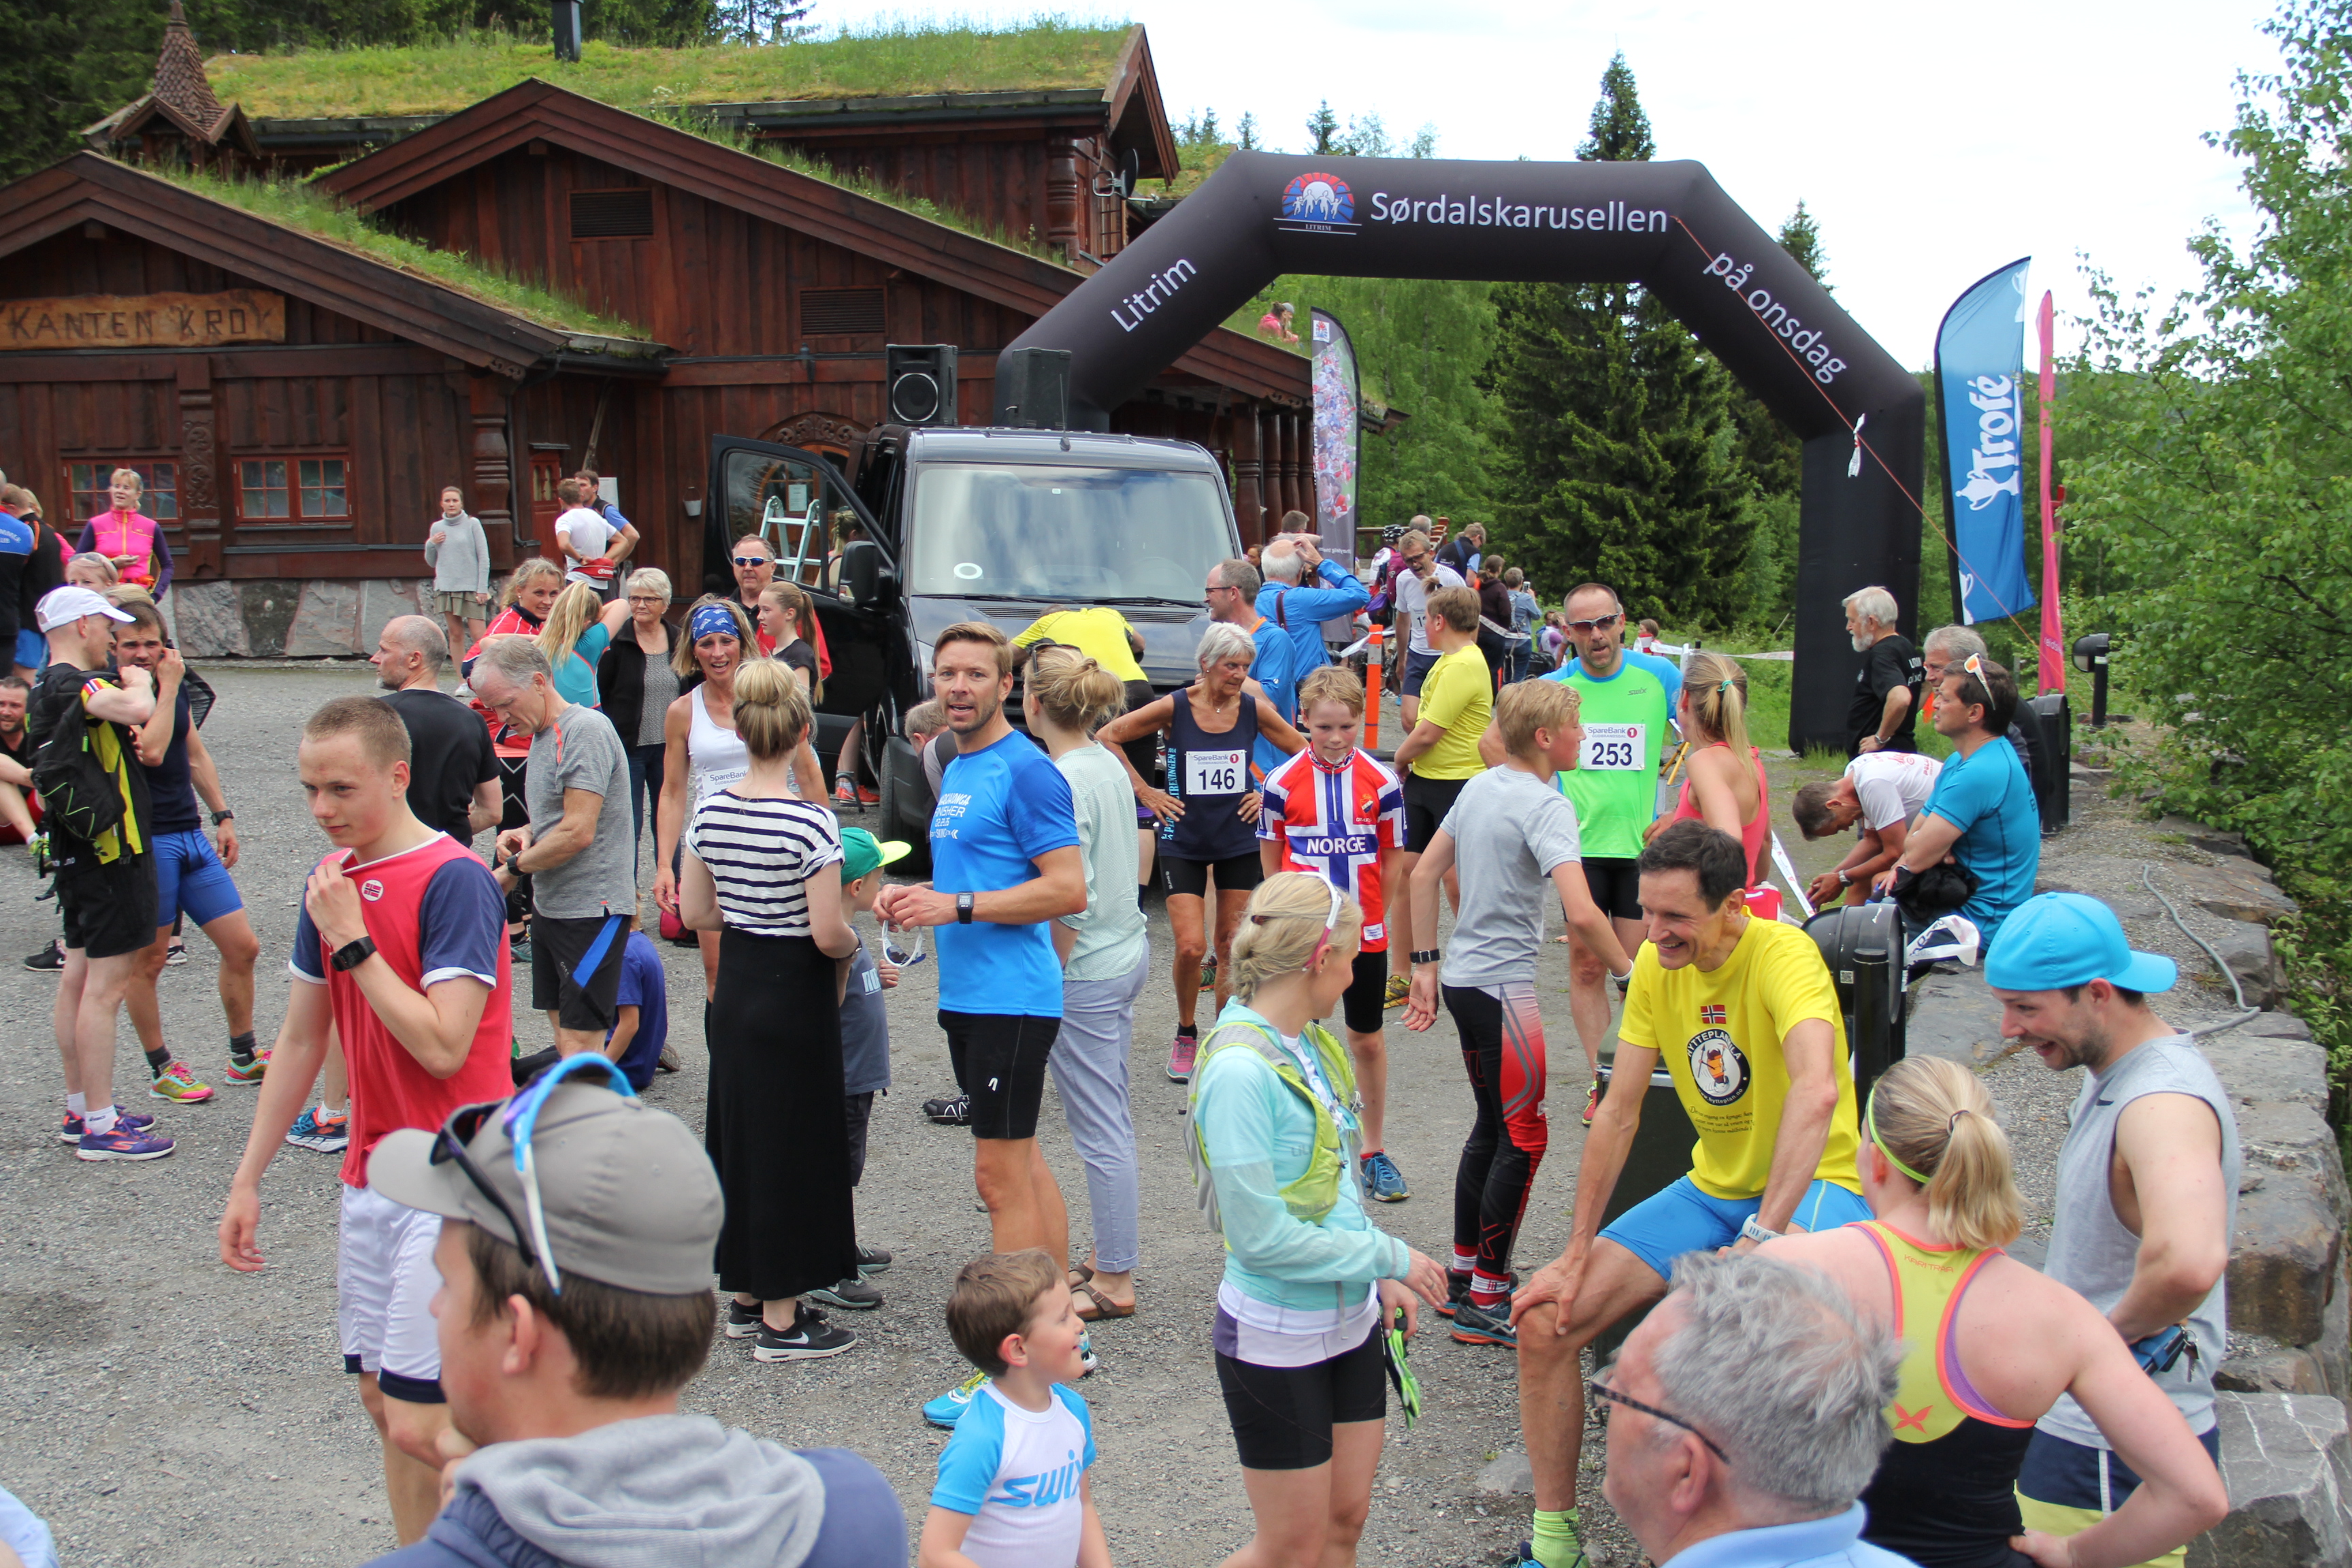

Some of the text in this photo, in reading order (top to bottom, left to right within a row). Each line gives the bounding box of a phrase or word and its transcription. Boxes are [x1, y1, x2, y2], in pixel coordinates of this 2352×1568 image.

[1305, 223, 1332, 231] LITRIM
[1370, 192, 1667, 233] Sørdalskarusellen
[1111, 259, 1196, 332] Litrim
[10, 306, 155, 340] KANTEN
[1703, 252, 1847, 384] på onsdag
[1967, 374, 2016, 478] Trofé
[1591, 742, 1632, 766] 253
[1198, 768, 1235, 790] 146
[1307, 836, 1366, 854] NORGE
[1904, 1254, 1927, 1269] KARI
